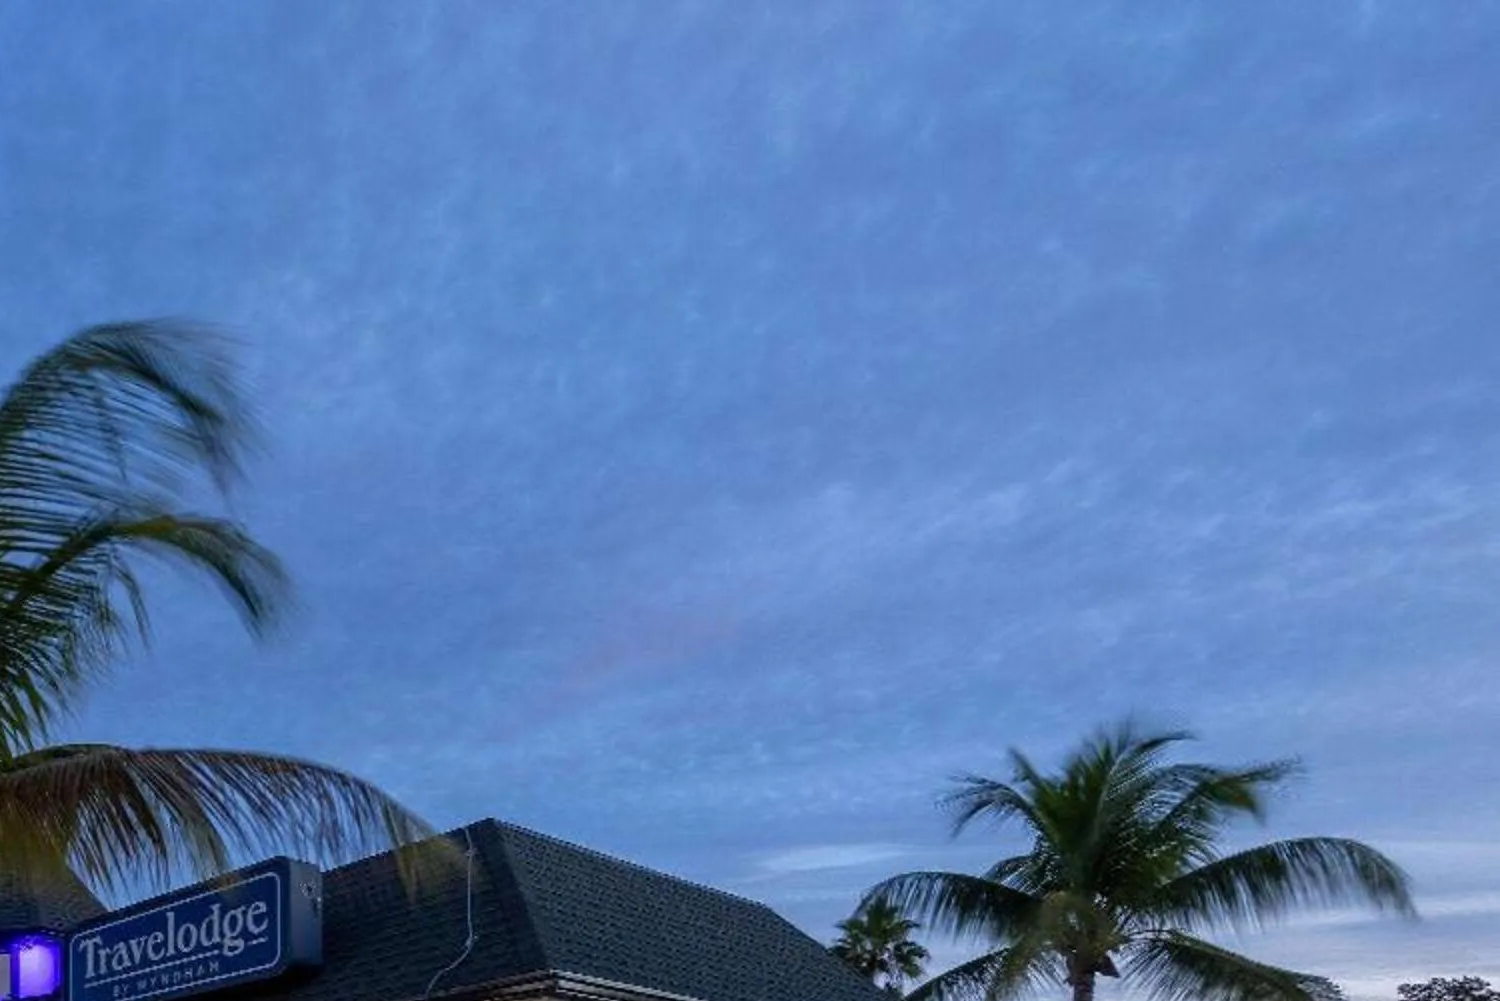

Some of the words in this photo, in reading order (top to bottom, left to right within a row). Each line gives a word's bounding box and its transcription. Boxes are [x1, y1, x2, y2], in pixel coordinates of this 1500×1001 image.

[78, 900, 270, 980] Travelodge
[113, 982, 130, 998] BY
[136, 960, 220, 991] WYNDHAM
